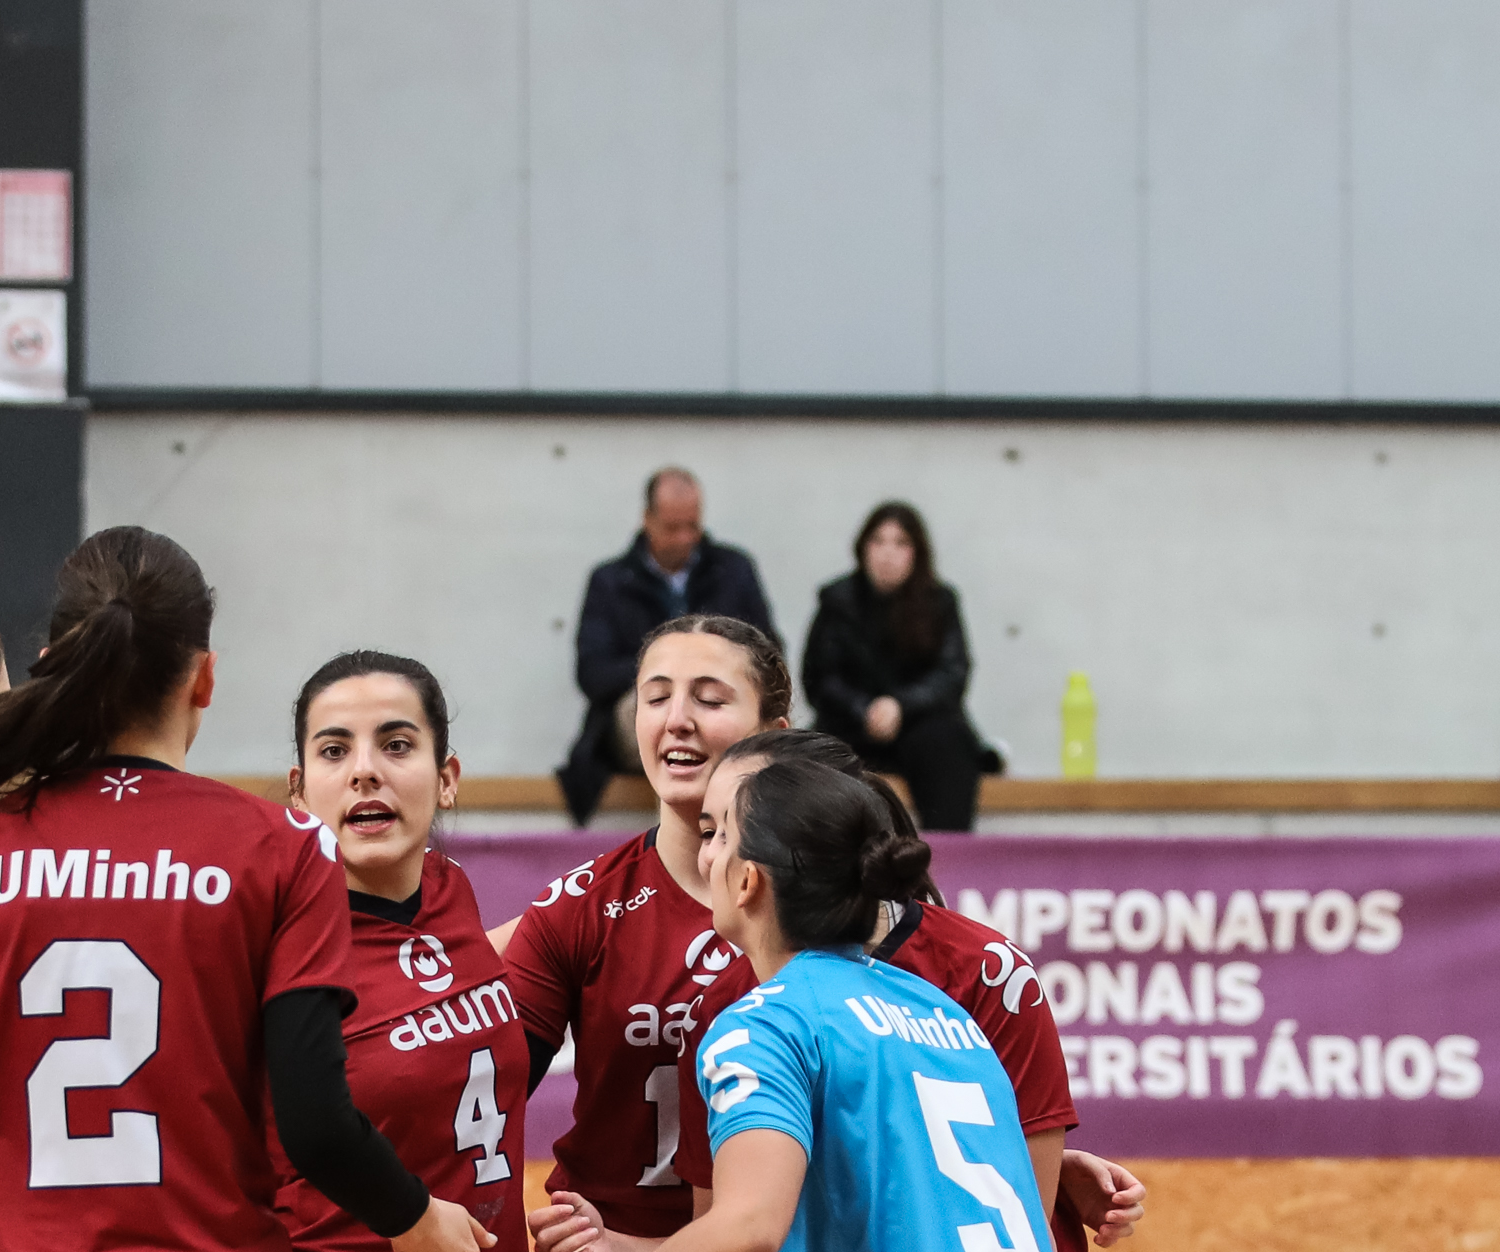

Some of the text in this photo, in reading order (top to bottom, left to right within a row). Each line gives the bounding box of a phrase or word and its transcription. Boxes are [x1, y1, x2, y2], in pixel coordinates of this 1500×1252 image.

[625, 886, 658, 912] cdt
[957, 887, 1405, 955] MPEONATOS
[624, 1003, 692, 1047] aa
[844, 995, 992, 1050] UMinho
[1043, 960, 1265, 1026] ONAIS
[18, 938, 162, 1189] 2
[702, 1027, 760, 1114] 5
[1068, 1020, 1484, 1101] ERSITÁRIOS
[453, 1046, 512, 1187] 4
